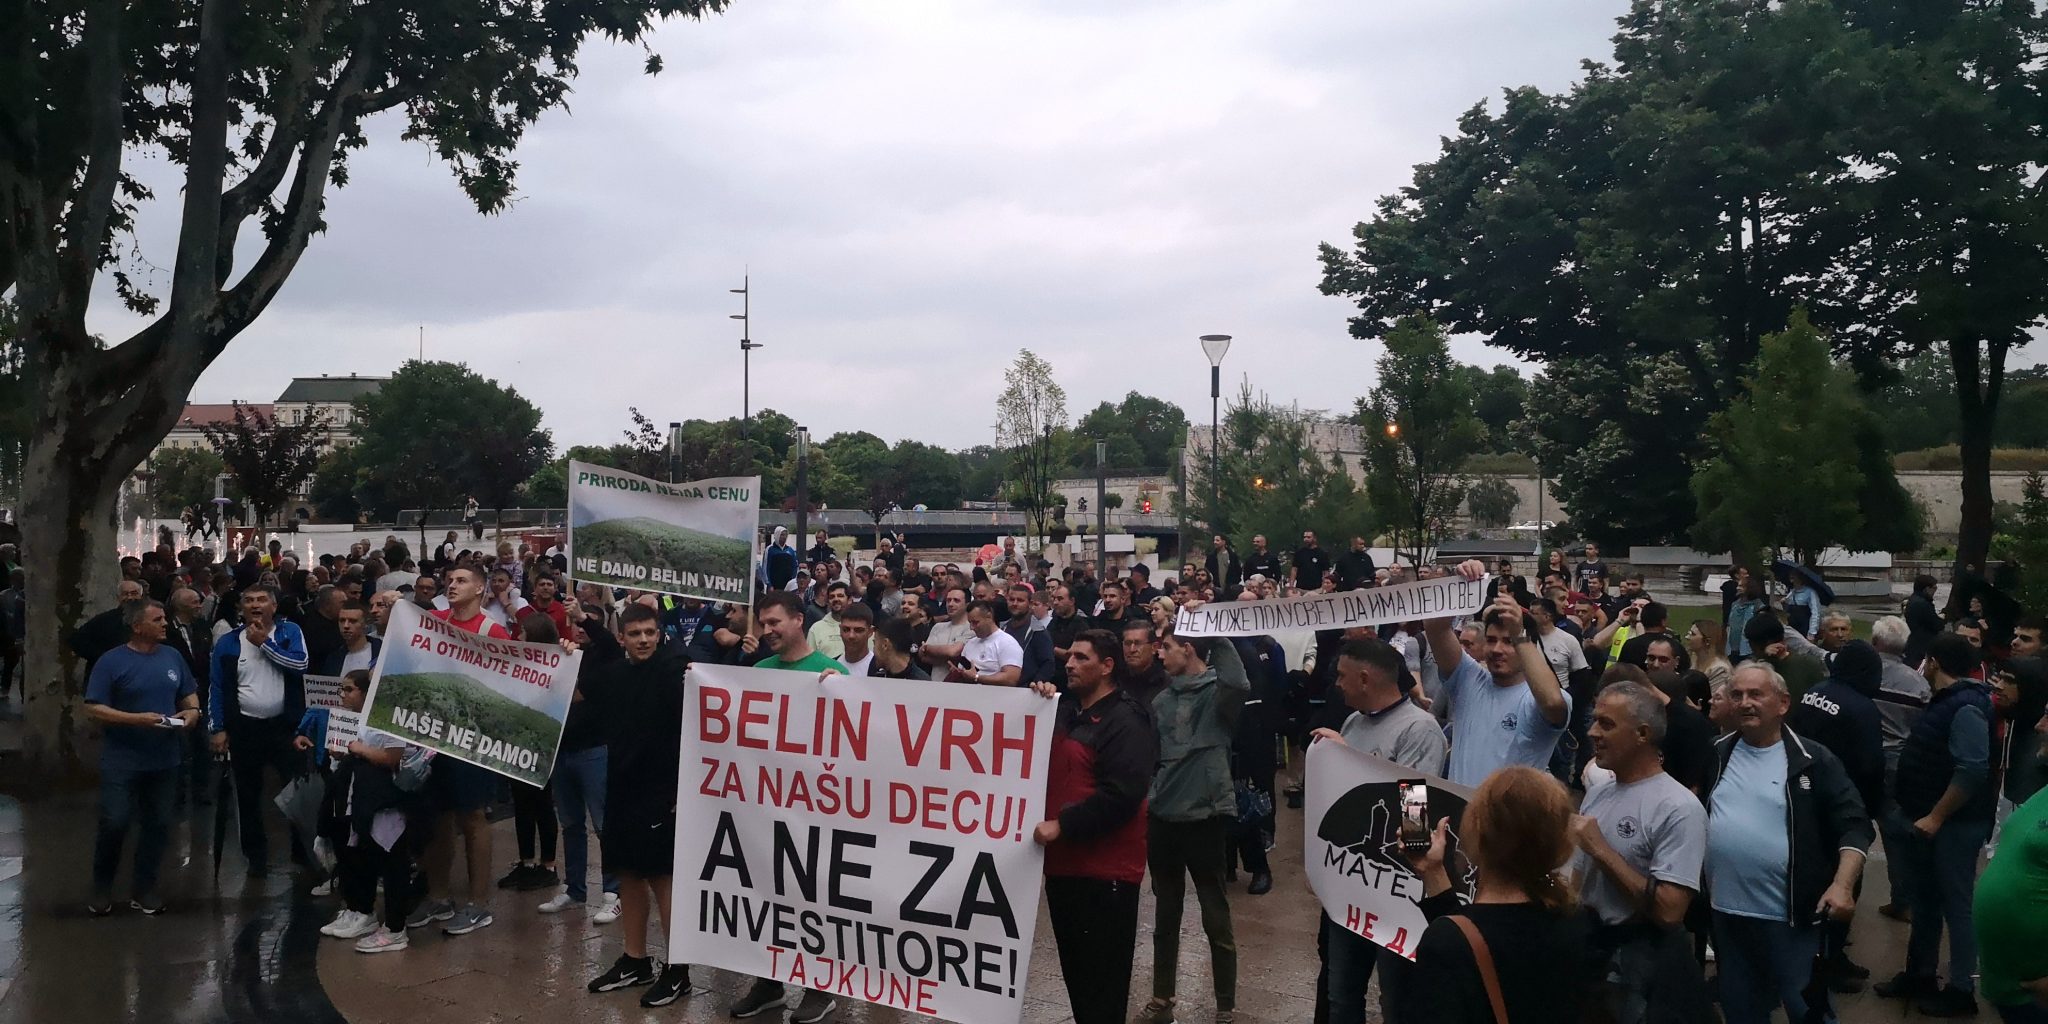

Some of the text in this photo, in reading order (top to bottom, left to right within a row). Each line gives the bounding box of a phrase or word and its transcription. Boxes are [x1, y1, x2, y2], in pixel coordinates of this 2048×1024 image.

[577, 471, 652, 494] PRIRODA
[708, 486, 750, 502] CENU
[576, 557, 744, 594] NE DAMO BELIN VRH!
[1178, 611, 1203, 633] НЕ
[1204, 607, 1251, 633] МОЖЕ
[1343, 595, 1368, 625] ДА
[1366, 589, 1407, 619] ИМА
[1408, 584, 1445, 617] ЦЕО
[1447, 577, 1487, 611] СВЕТ
[410, 633, 553, 689] PA OTIMAJTE BRDO!
[418, 614, 456, 639] IDITE
[523, 647, 561, 668] SELO
[391, 706, 539, 773] NAŠE NE DAMO!
[699, 685, 1037, 781] BELIN VRH
[699, 757, 1027, 843] ZA NAŠU DECU!
[698, 810, 1021, 940] A NE ZA
[1324, 843, 1420, 907] МАТЕ
[698, 889, 1019, 999] INVESTITORE!
[1346, 903, 1418, 960] НЕ Д
[765, 945, 940, 1016] TAJKUNE
